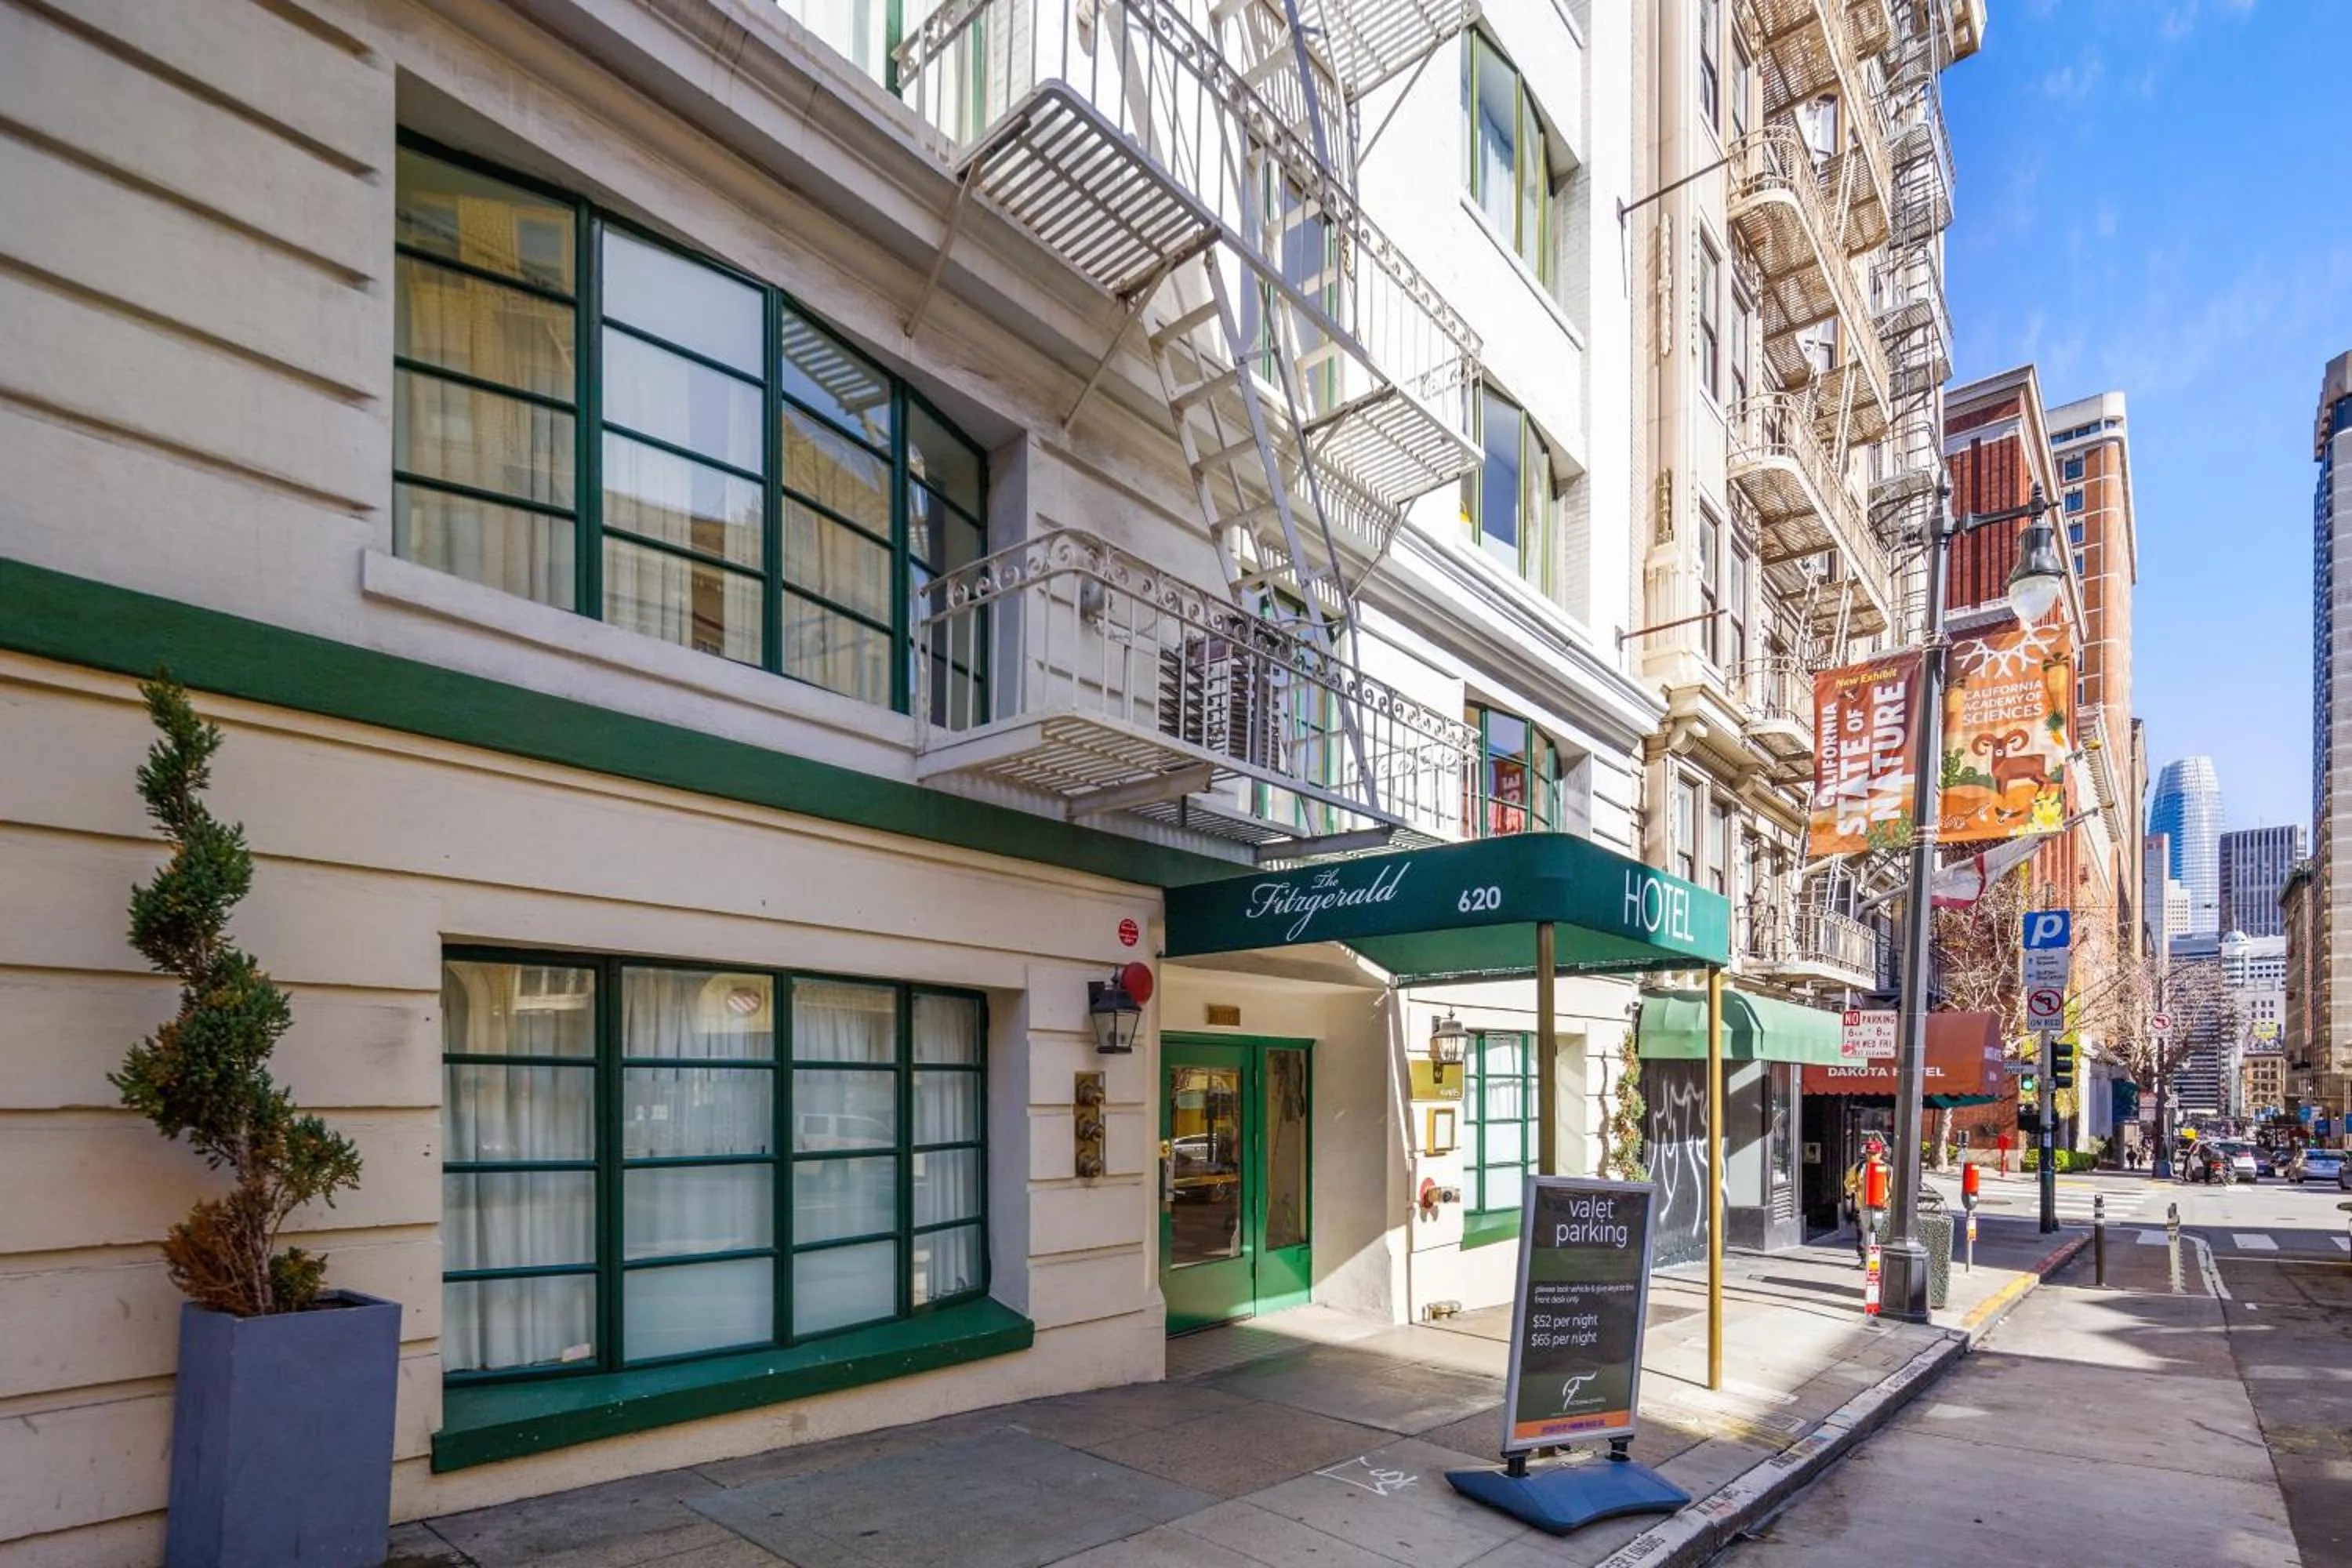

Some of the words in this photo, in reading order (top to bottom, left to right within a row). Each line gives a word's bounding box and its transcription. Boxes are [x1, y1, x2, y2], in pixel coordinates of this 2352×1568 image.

[1836, 677, 1859, 688] New
[1861, 667, 1897, 684] Exhibit
[1963, 679, 2043, 700] CALIFORNIA
[1963, 694, 2024, 712] ACADEMY
[2025, 691, 2045, 702] OF
[1846, 708, 1864, 732] OF
[1962, 702, 2043, 728] SCIENCES
[1820, 702, 1838, 807] CALIFORNIA
[1871, 681, 1907, 822] NATURE
[1836, 735, 1871, 837] STATE
[1311, 868, 1340, 890] The
[1246, 862, 1412, 942] Fitzgerald
[1457, 886, 1501, 913] 620
[1624, 868, 1694, 942] HOTEL
[1845, 1012, 1859, 1025] NO
[1862, 1014, 1895, 1025] PARKING
[1828, 1067, 1889, 1077] DAKOTA
[1569, 1195, 1615, 1219] valet
[1555, 1218, 1628, 1248] parking
[1533, 1315, 1552, 1329] $52
[1553, 1317, 1570, 1330] per
[1572, 1313, 1599, 1329] night
[1531, 1334, 1552, 1347] $65
[1552, 1334, 1570, 1348] per
[1570, 1331, 1597, 1346] night
